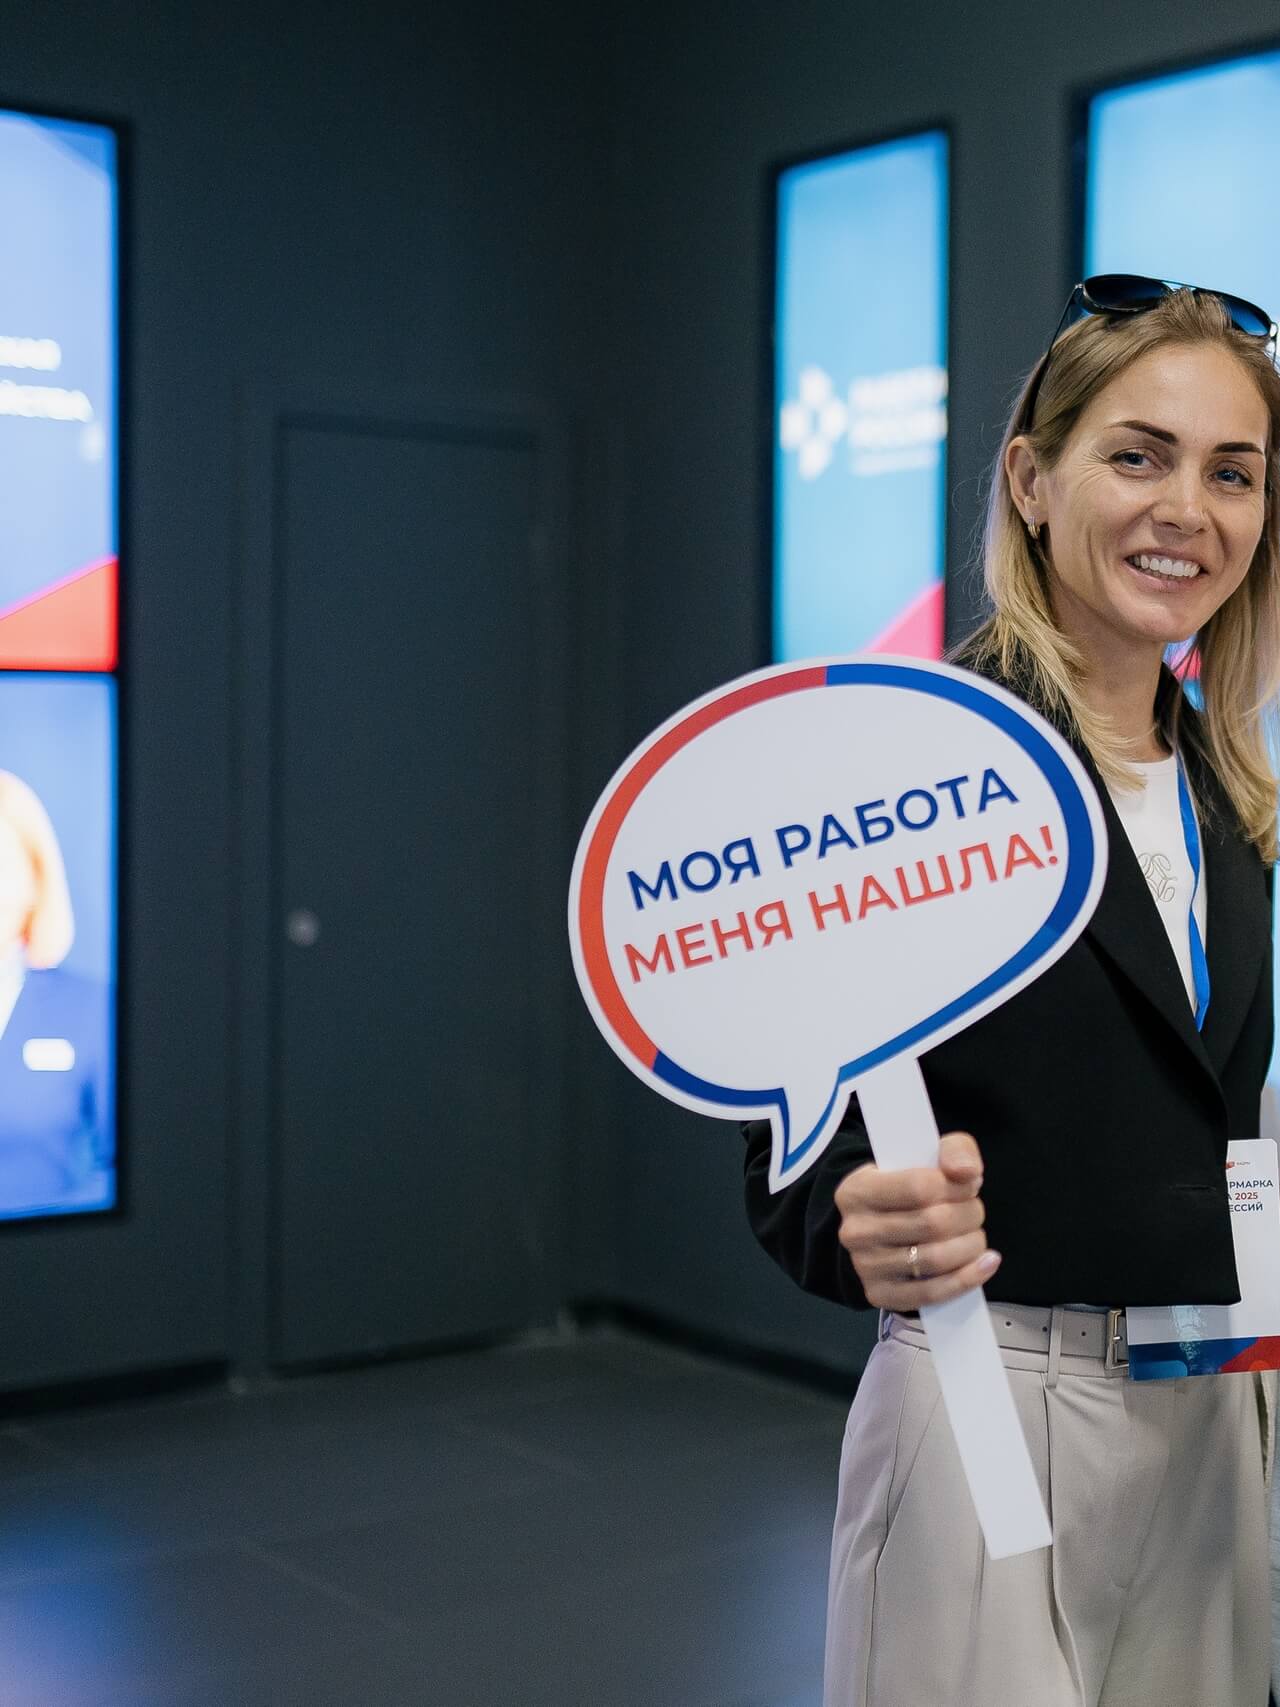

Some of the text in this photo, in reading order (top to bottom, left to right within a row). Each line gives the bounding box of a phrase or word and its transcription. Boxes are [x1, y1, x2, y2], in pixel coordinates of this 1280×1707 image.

[627, 768, 1018, 910] МОЯ РАБОТА
[624, 825, 1057, 981] МЕНЯ НАШЛА!
[1229, 1180, 1273, 1188] РМАРКА
[1235, 1192, 1258, 1200] 2025
[1229, 1202, 1263, 1212] ЕССИЙ
